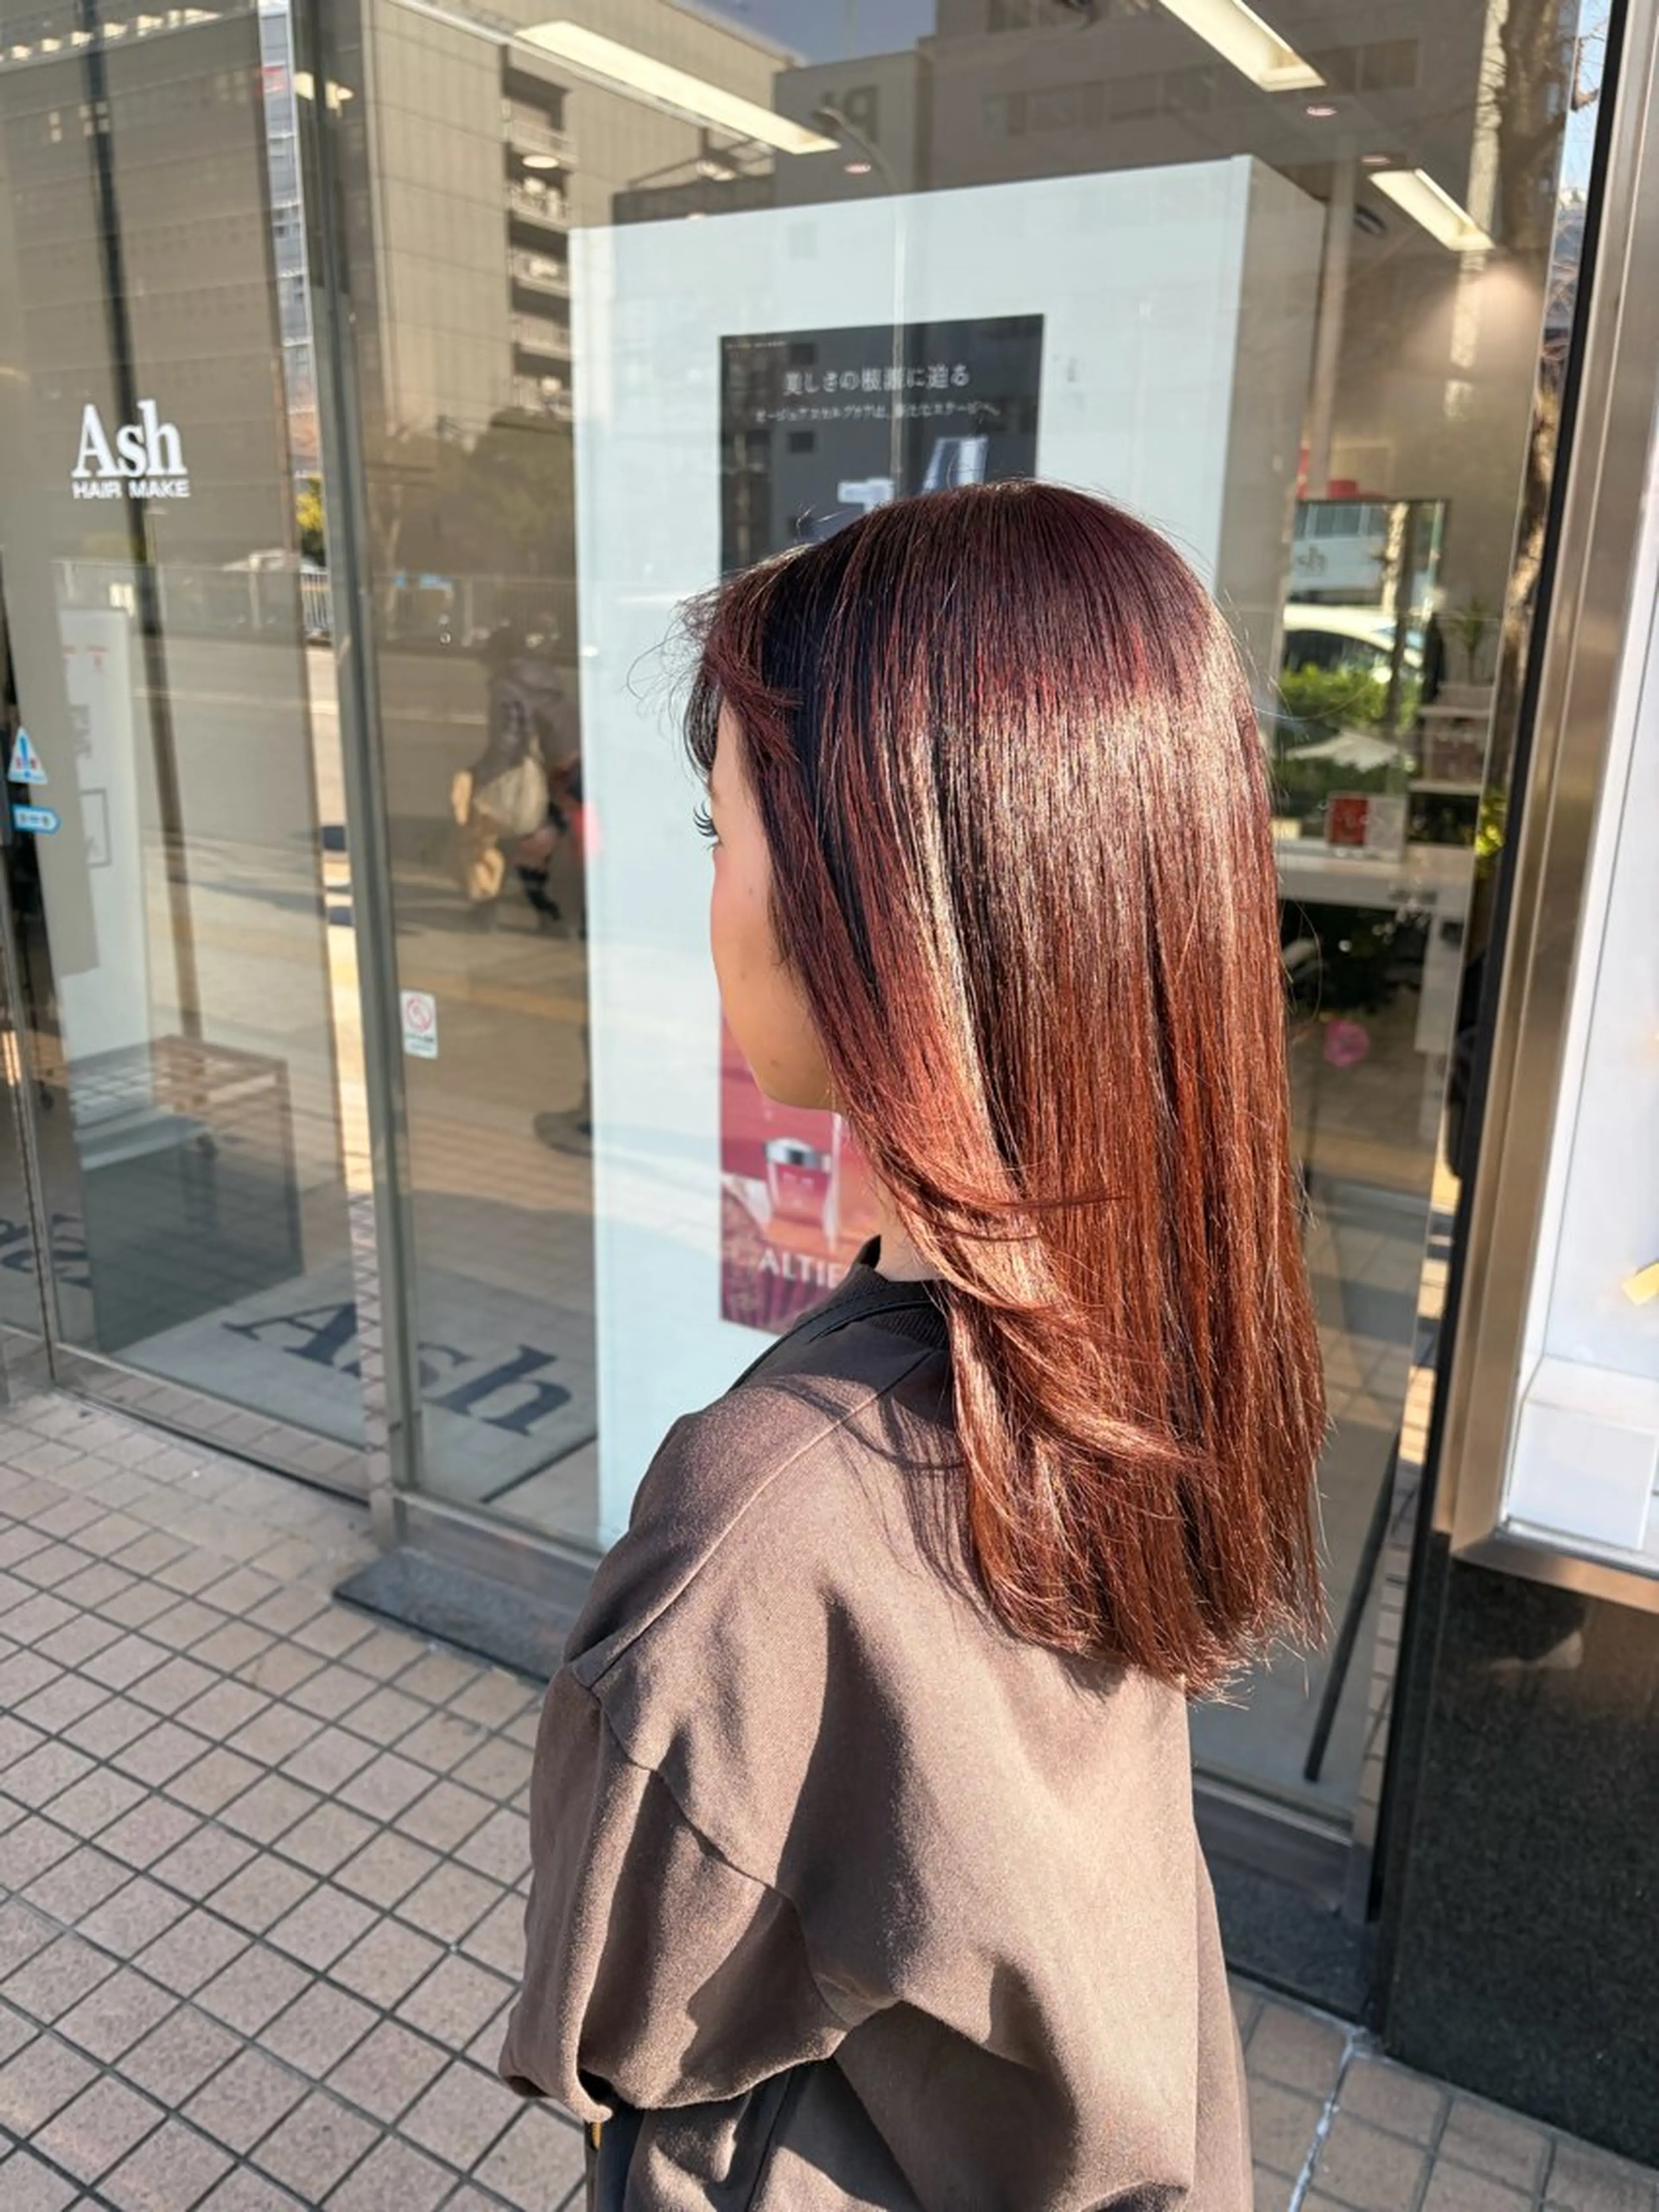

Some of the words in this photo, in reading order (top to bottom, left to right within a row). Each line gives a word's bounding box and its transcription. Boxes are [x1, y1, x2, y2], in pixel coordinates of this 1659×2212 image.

[783, 363, 970, 396] 美しさの根源に迫る
[71, 399, 188, 477] Ash
[72, 480, 123, 499] HAIR
[128, 479, 191, 499] MAKE
[758, 1248, 850, 1290] ALTIE
